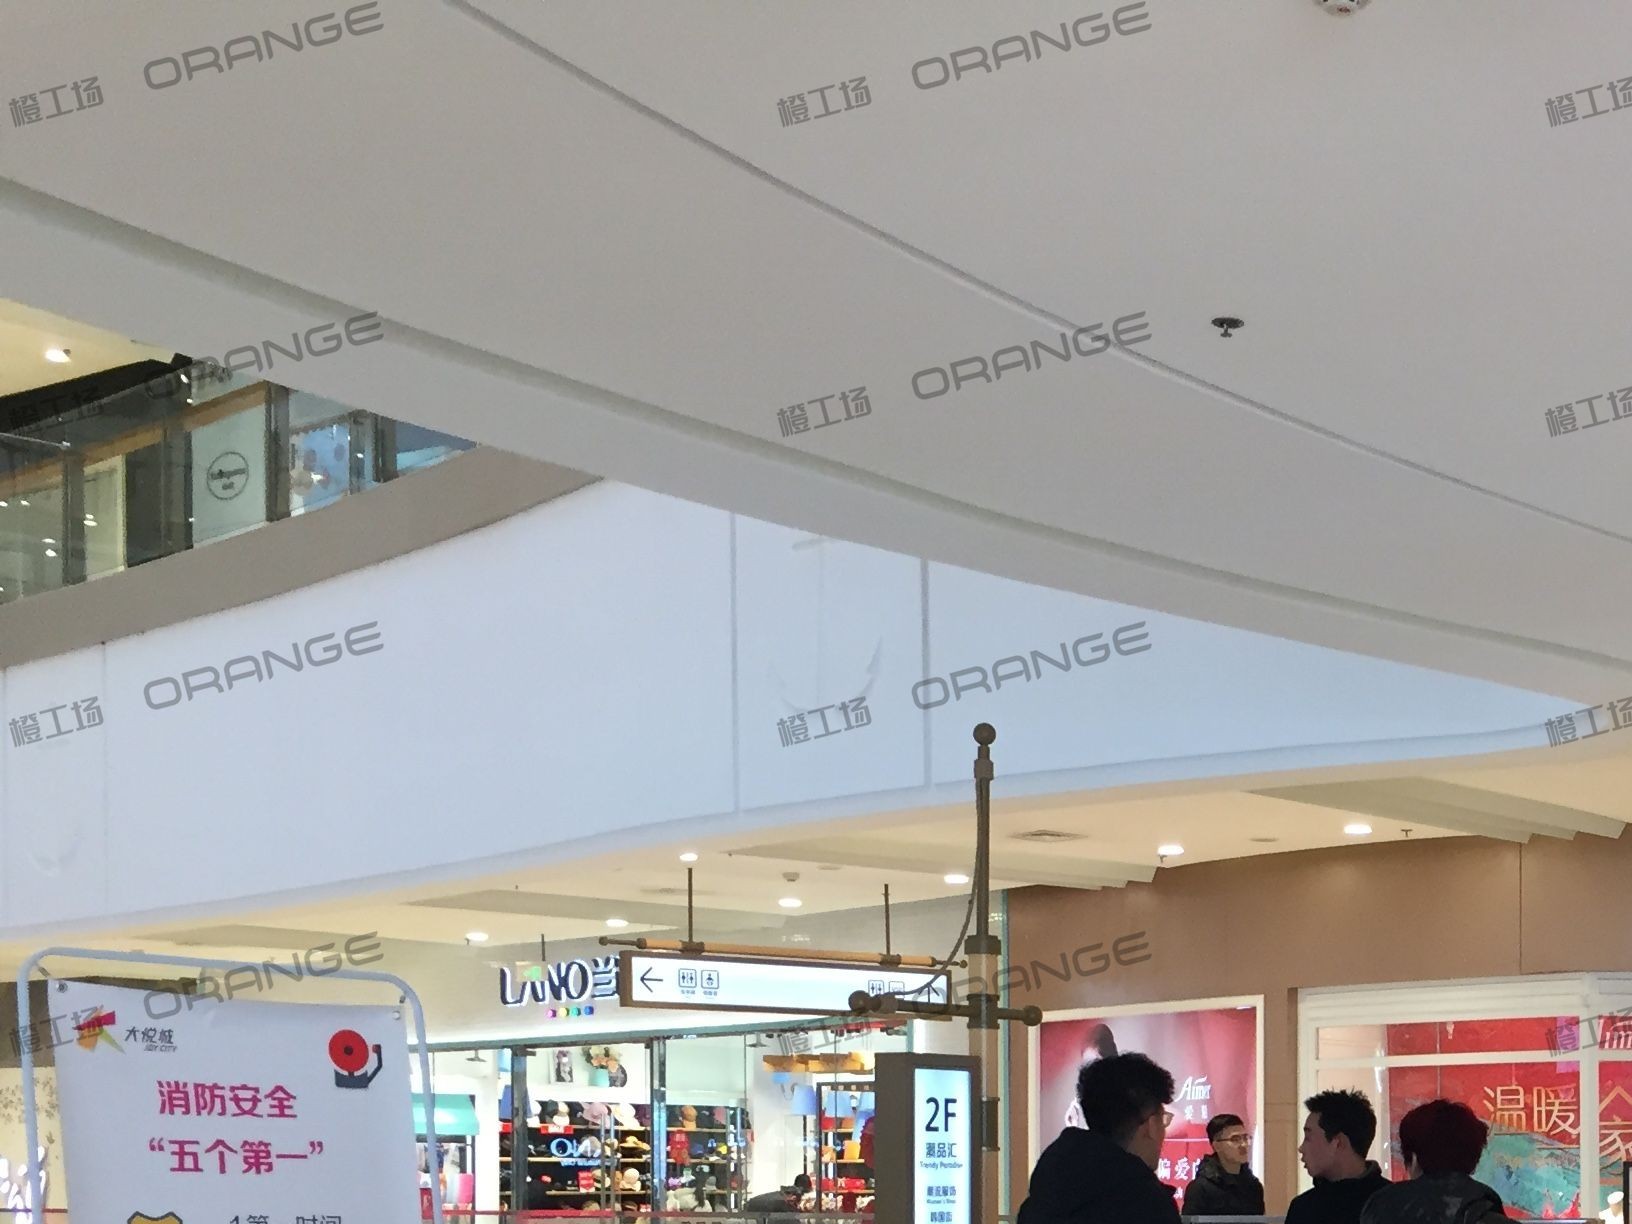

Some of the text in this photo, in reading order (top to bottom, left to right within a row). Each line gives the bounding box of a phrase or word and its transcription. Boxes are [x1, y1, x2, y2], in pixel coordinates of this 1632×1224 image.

[124, 1026, 174, 1045] 大悦城
[157, 1080, 298, 1120] 消防安全
[925, 1096, 958, 1133] 2F
[1482, 1084, 1581, 1137] 温暖
[149, 1139, 325, 1176] “五个第一”
